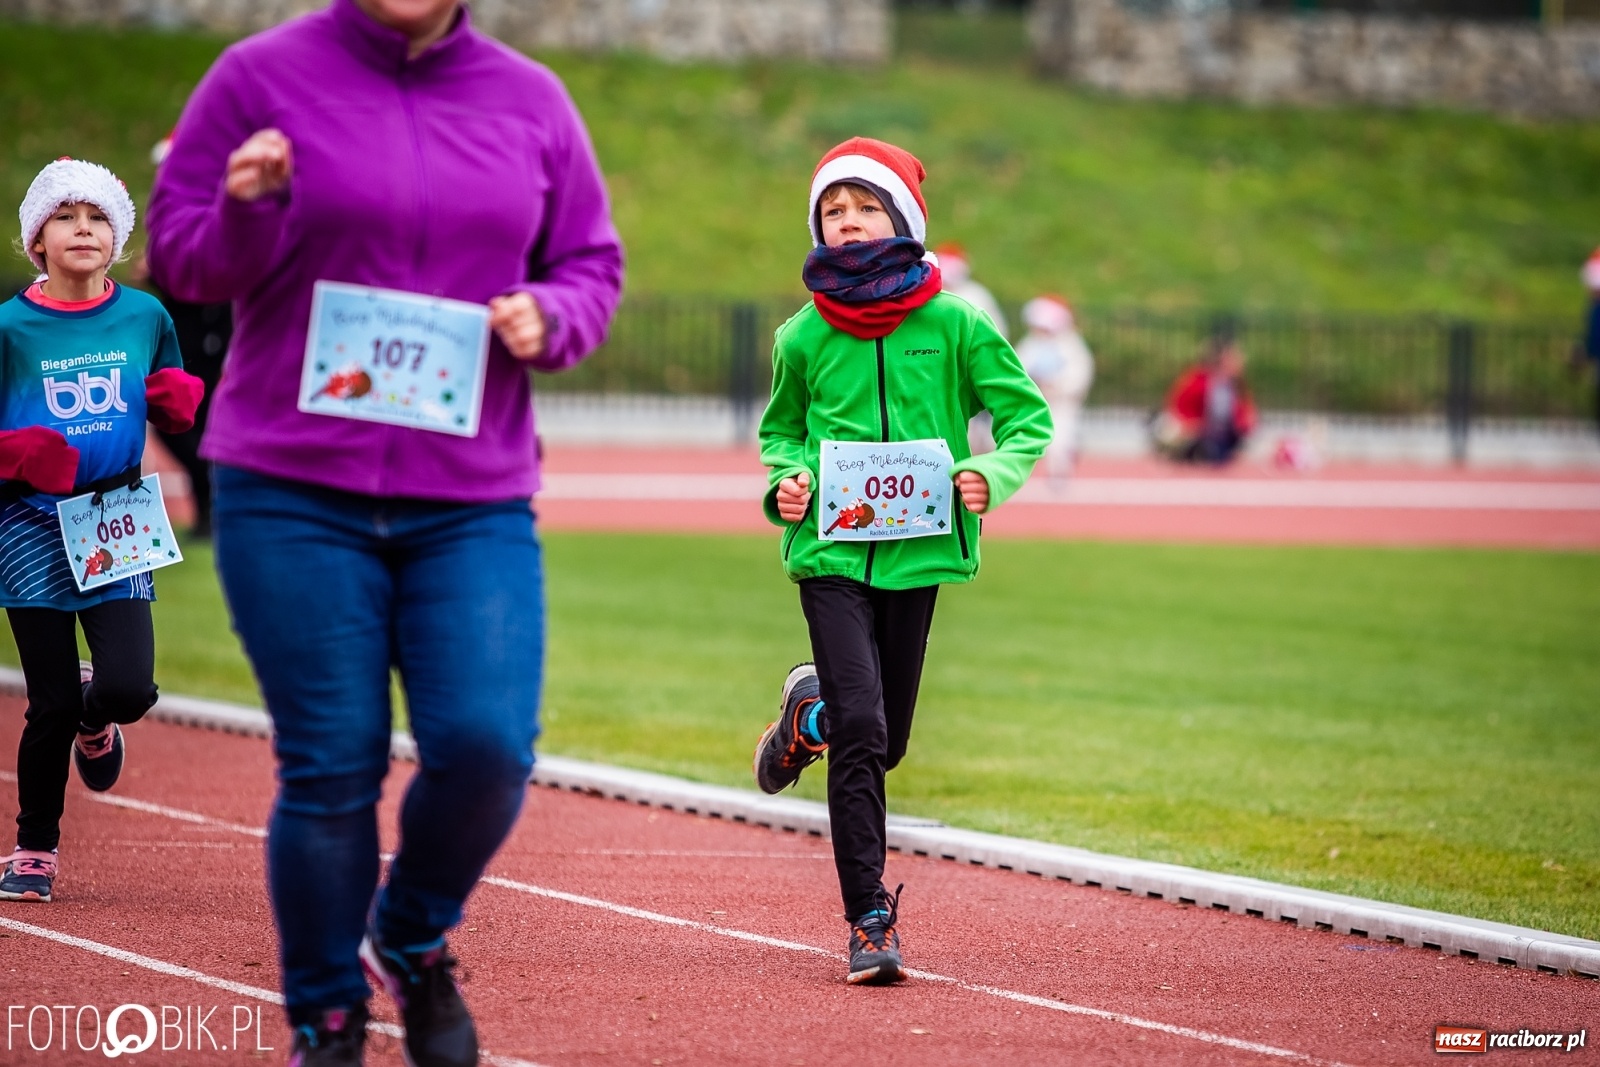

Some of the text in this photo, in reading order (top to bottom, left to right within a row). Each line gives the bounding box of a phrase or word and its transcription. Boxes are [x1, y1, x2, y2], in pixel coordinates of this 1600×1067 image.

[41, 349, 127, 371] BiegamBoLubię
[371, 336, 429, 374] 107
[42, 367, 128, 420] bbl
[864, 474, 915, 500] 030
[96, 513, 136, 544] 068
